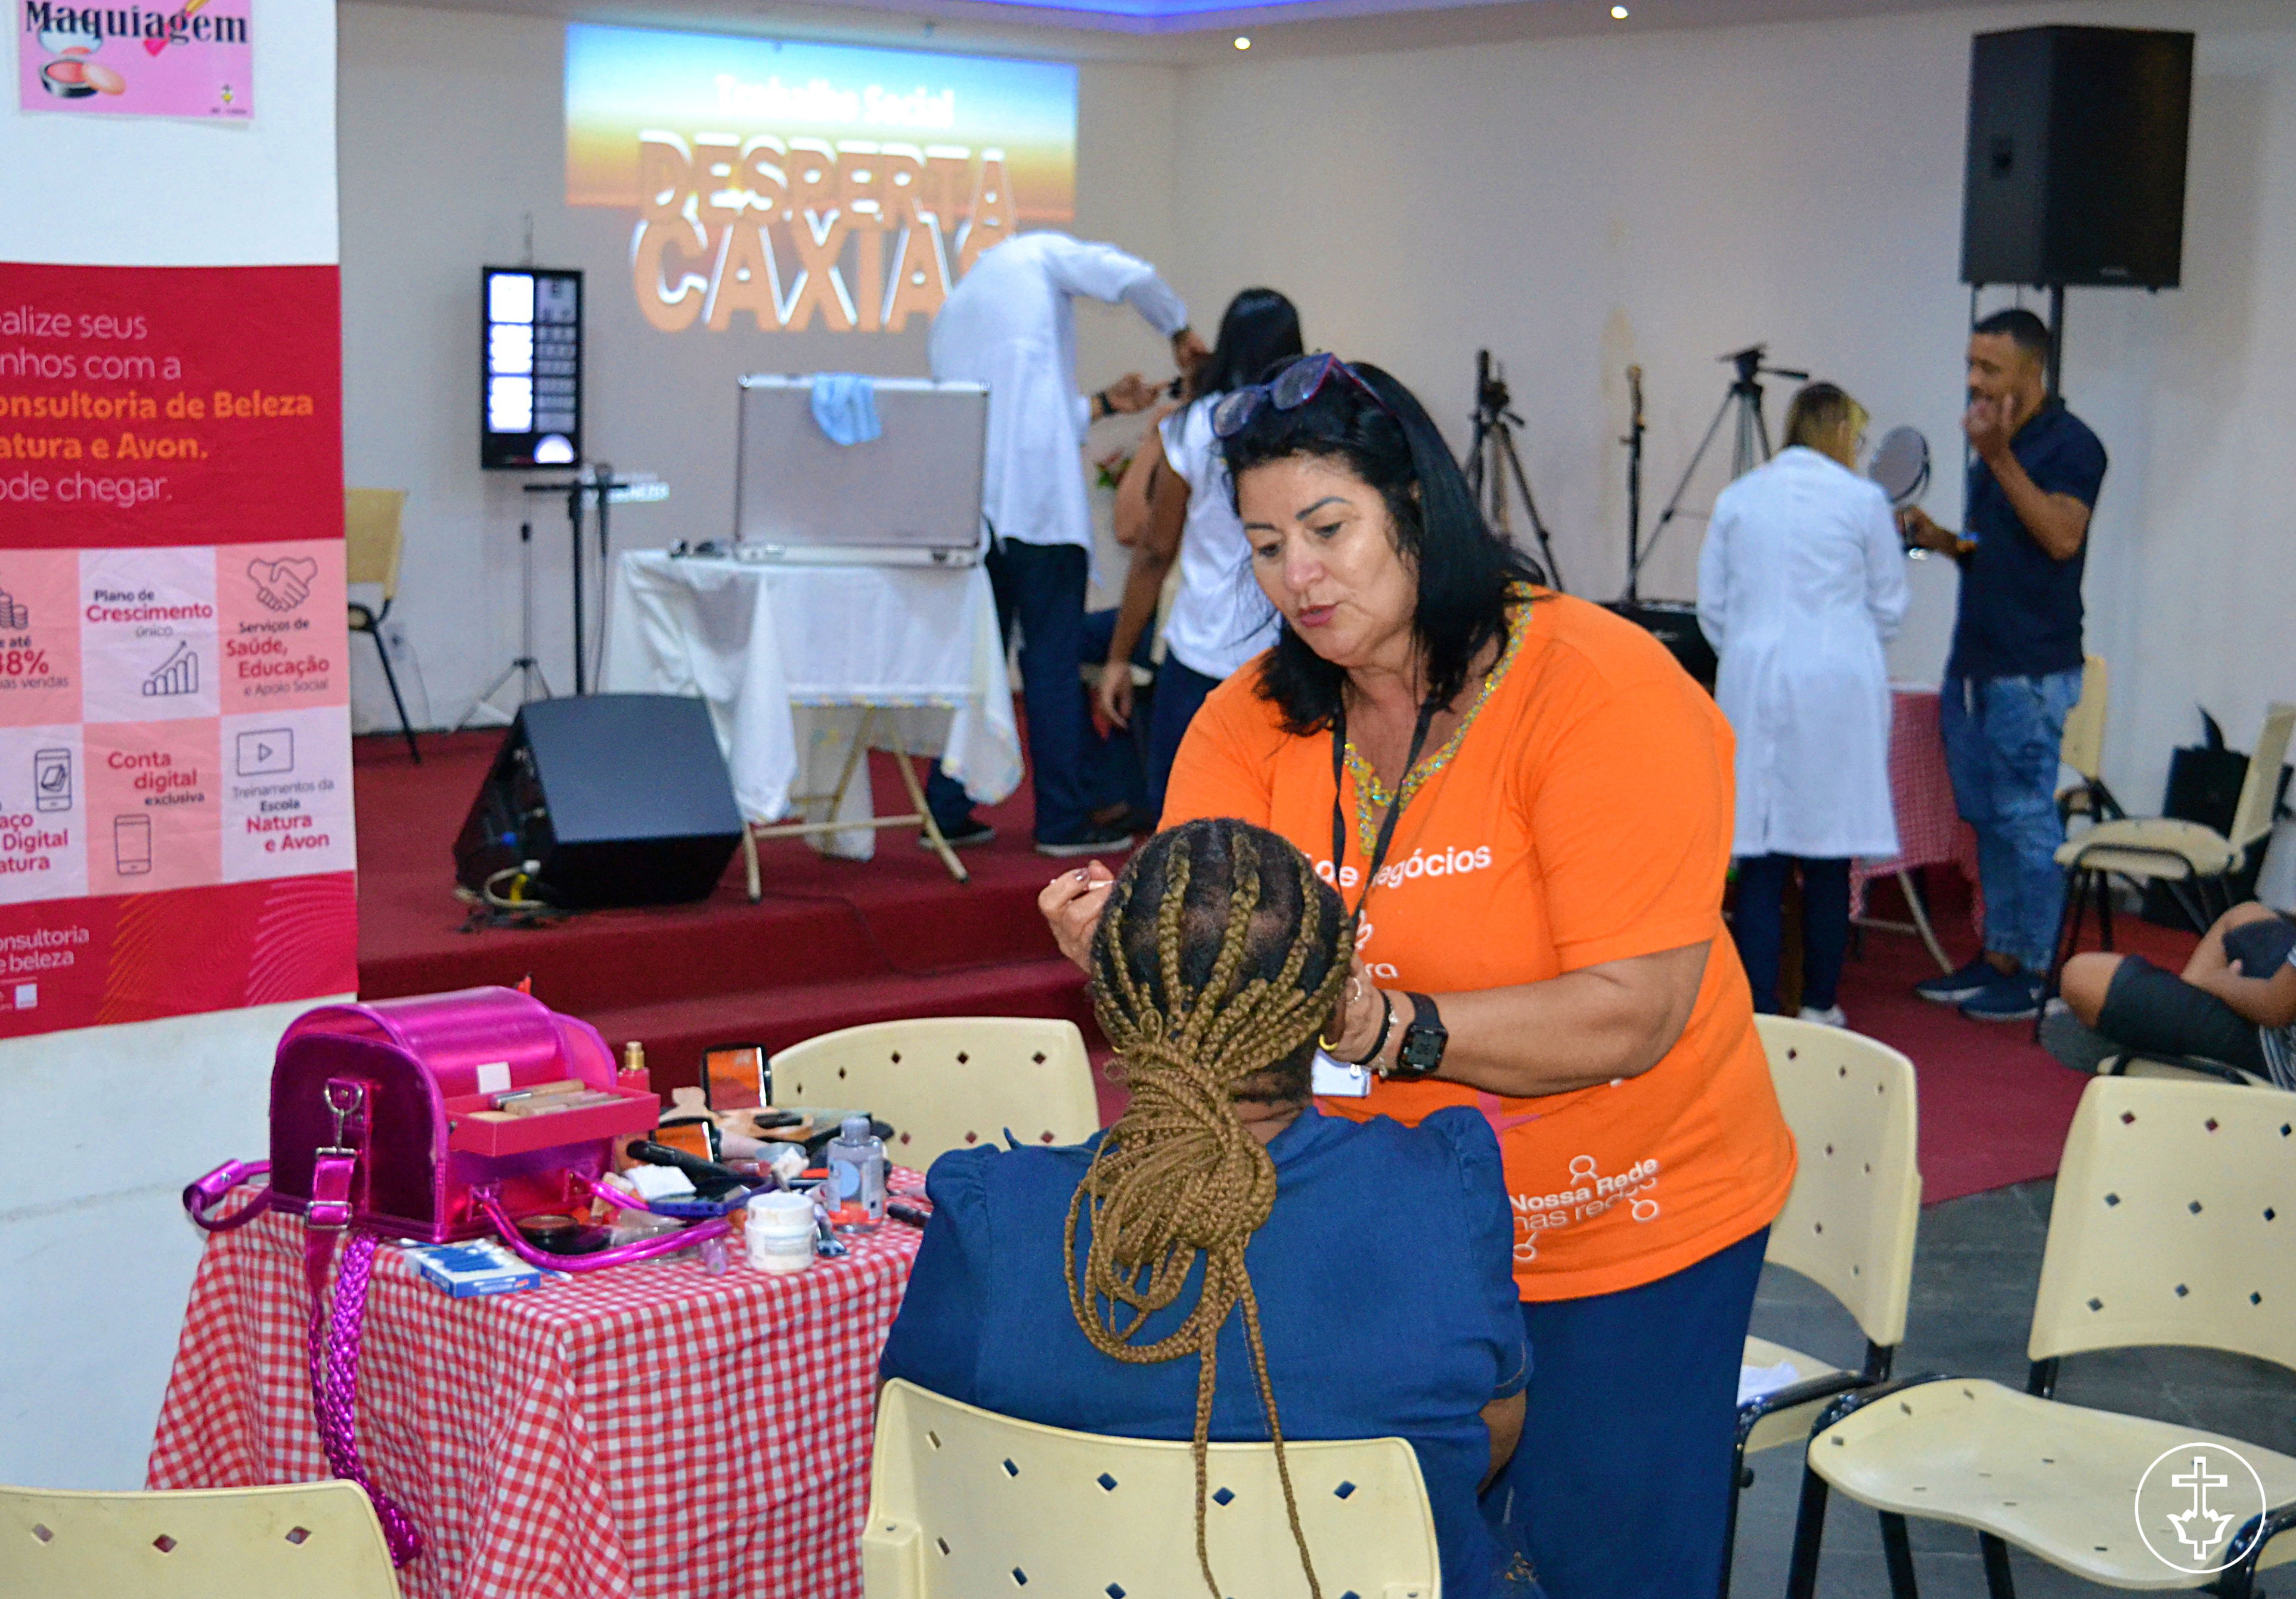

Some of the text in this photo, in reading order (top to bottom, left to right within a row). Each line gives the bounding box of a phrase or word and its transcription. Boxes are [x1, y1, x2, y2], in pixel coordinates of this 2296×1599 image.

[26, 1, 249, 45] Maquiagem
[638, 129, 1018, 234] DESPERTA
[0, 305, 148, 340] alize seus
[83, 357, 156, 380] com
[162, 357, 181, 380] a
[166, 391, 205, 419] de
[213, 389, 314, 418] Beleza
[91, 438, 110, 460] e
[117, 431, 209, 460] Avon.
[56, 470, 172, 509] chegar.
[94, 588, 155, 602] Plano de
[86, 603, 213, 622] Crescimento
[240, 617, 310, 634] Serviços de
[10, 634, 32, 648] até
[226, 636, 289, 656] Saúde,
[0, 649, 49, 676] 8%
[238, 655, 331, 679] Educação
[21, 675, 69, 689] vendas
[108, 752, 172, 769] Conta
[134, 768, 198, 793] digital
[232, 779, 334, 798] Treinamentos da
[144, 791, 205, 805] exclusiva
[260, 798, 300, 812] Escola
[247, 814, 312, 834] Natura
[4, 827, 69, 854] Digital
[264, 833, 330, 853] e Avon
[1371, 845, 1492, 889] egócios
[9, 950, 75, 972] beleza
[1509, 1157, 1661, 1212] Nossa Rede
